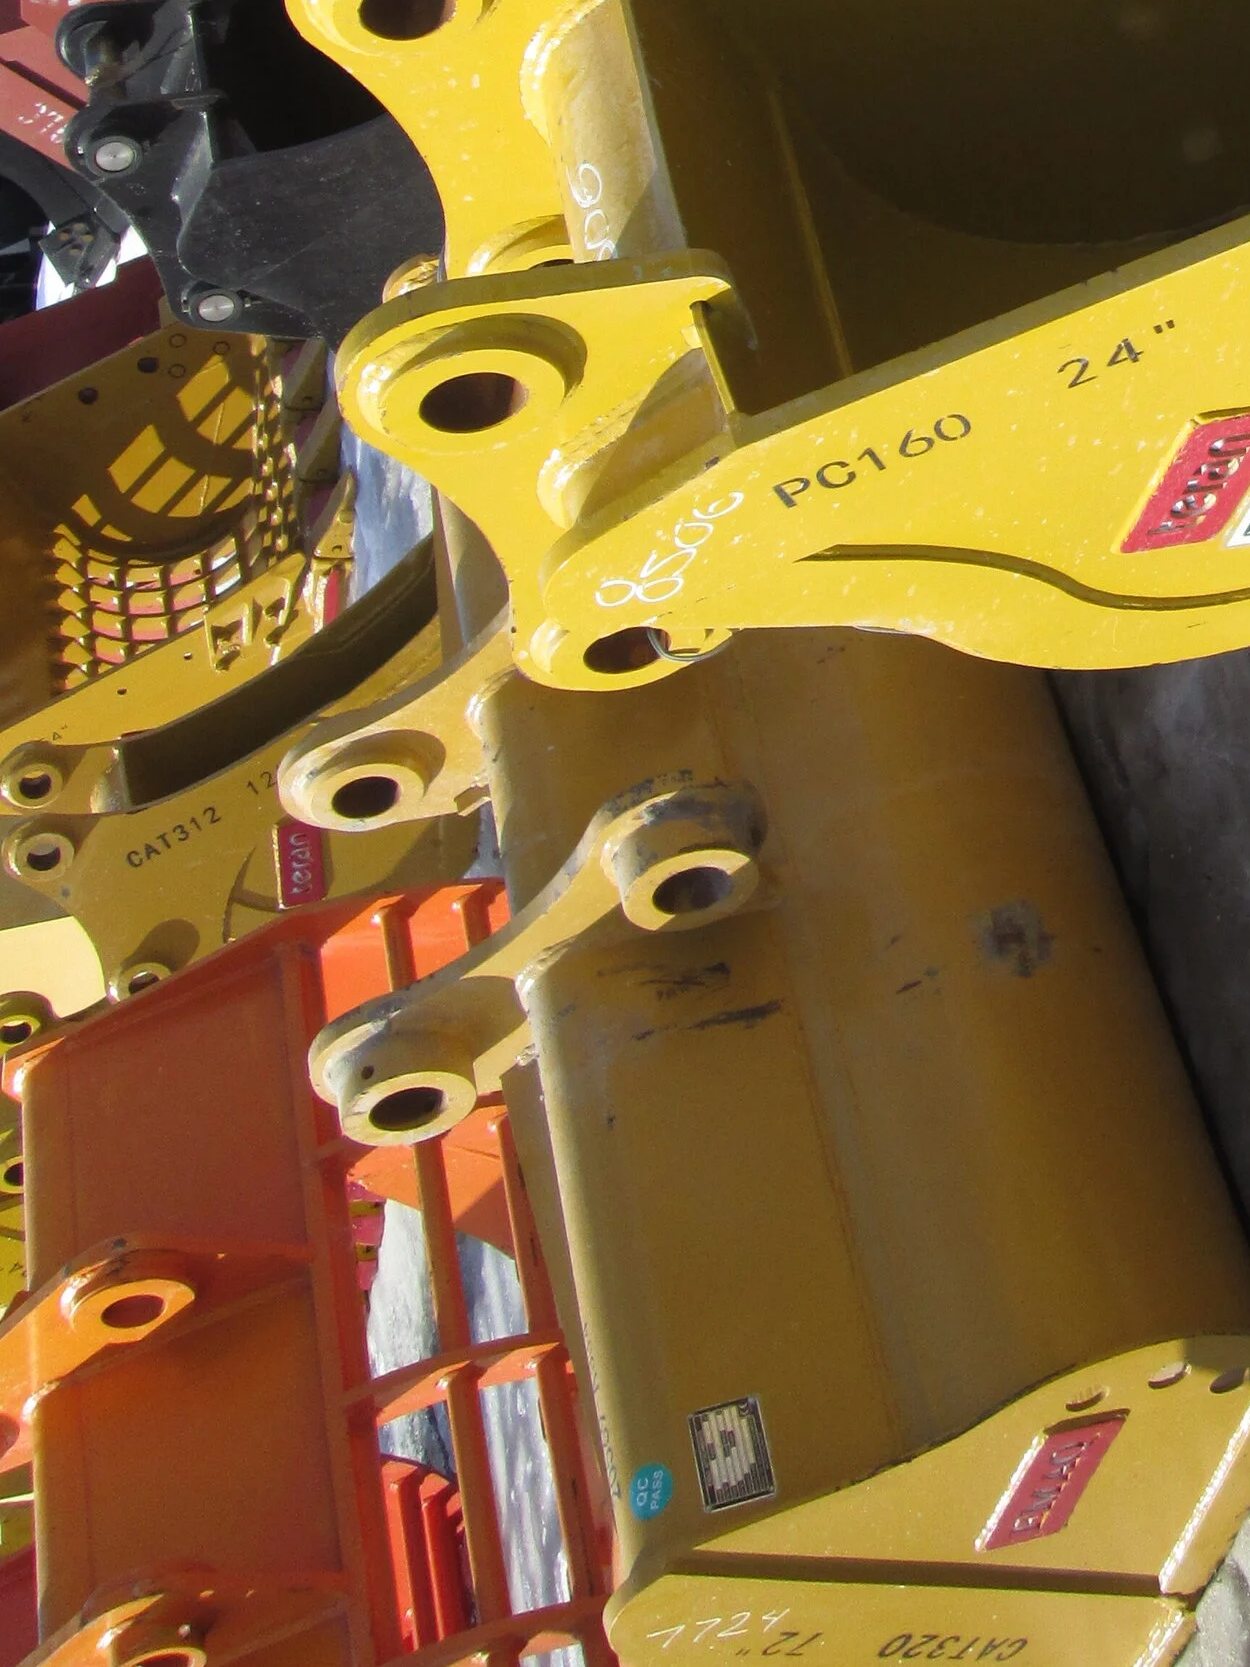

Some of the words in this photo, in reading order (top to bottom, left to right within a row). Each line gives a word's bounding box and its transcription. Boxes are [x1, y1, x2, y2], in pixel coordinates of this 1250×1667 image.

[771, 411, 973, 511] PC160
[1054, 316, 1178, 390] 24"
[125, 807, 223, 871] CAT312
[286, 830, 313, 898] teran
[635, 1476, 650, 1507] QC
[649, 1469, 665, 1512] PASS
[734, 1630, 824, 1659] 72"
[877, 1632, 1030, 1662] CAT320
